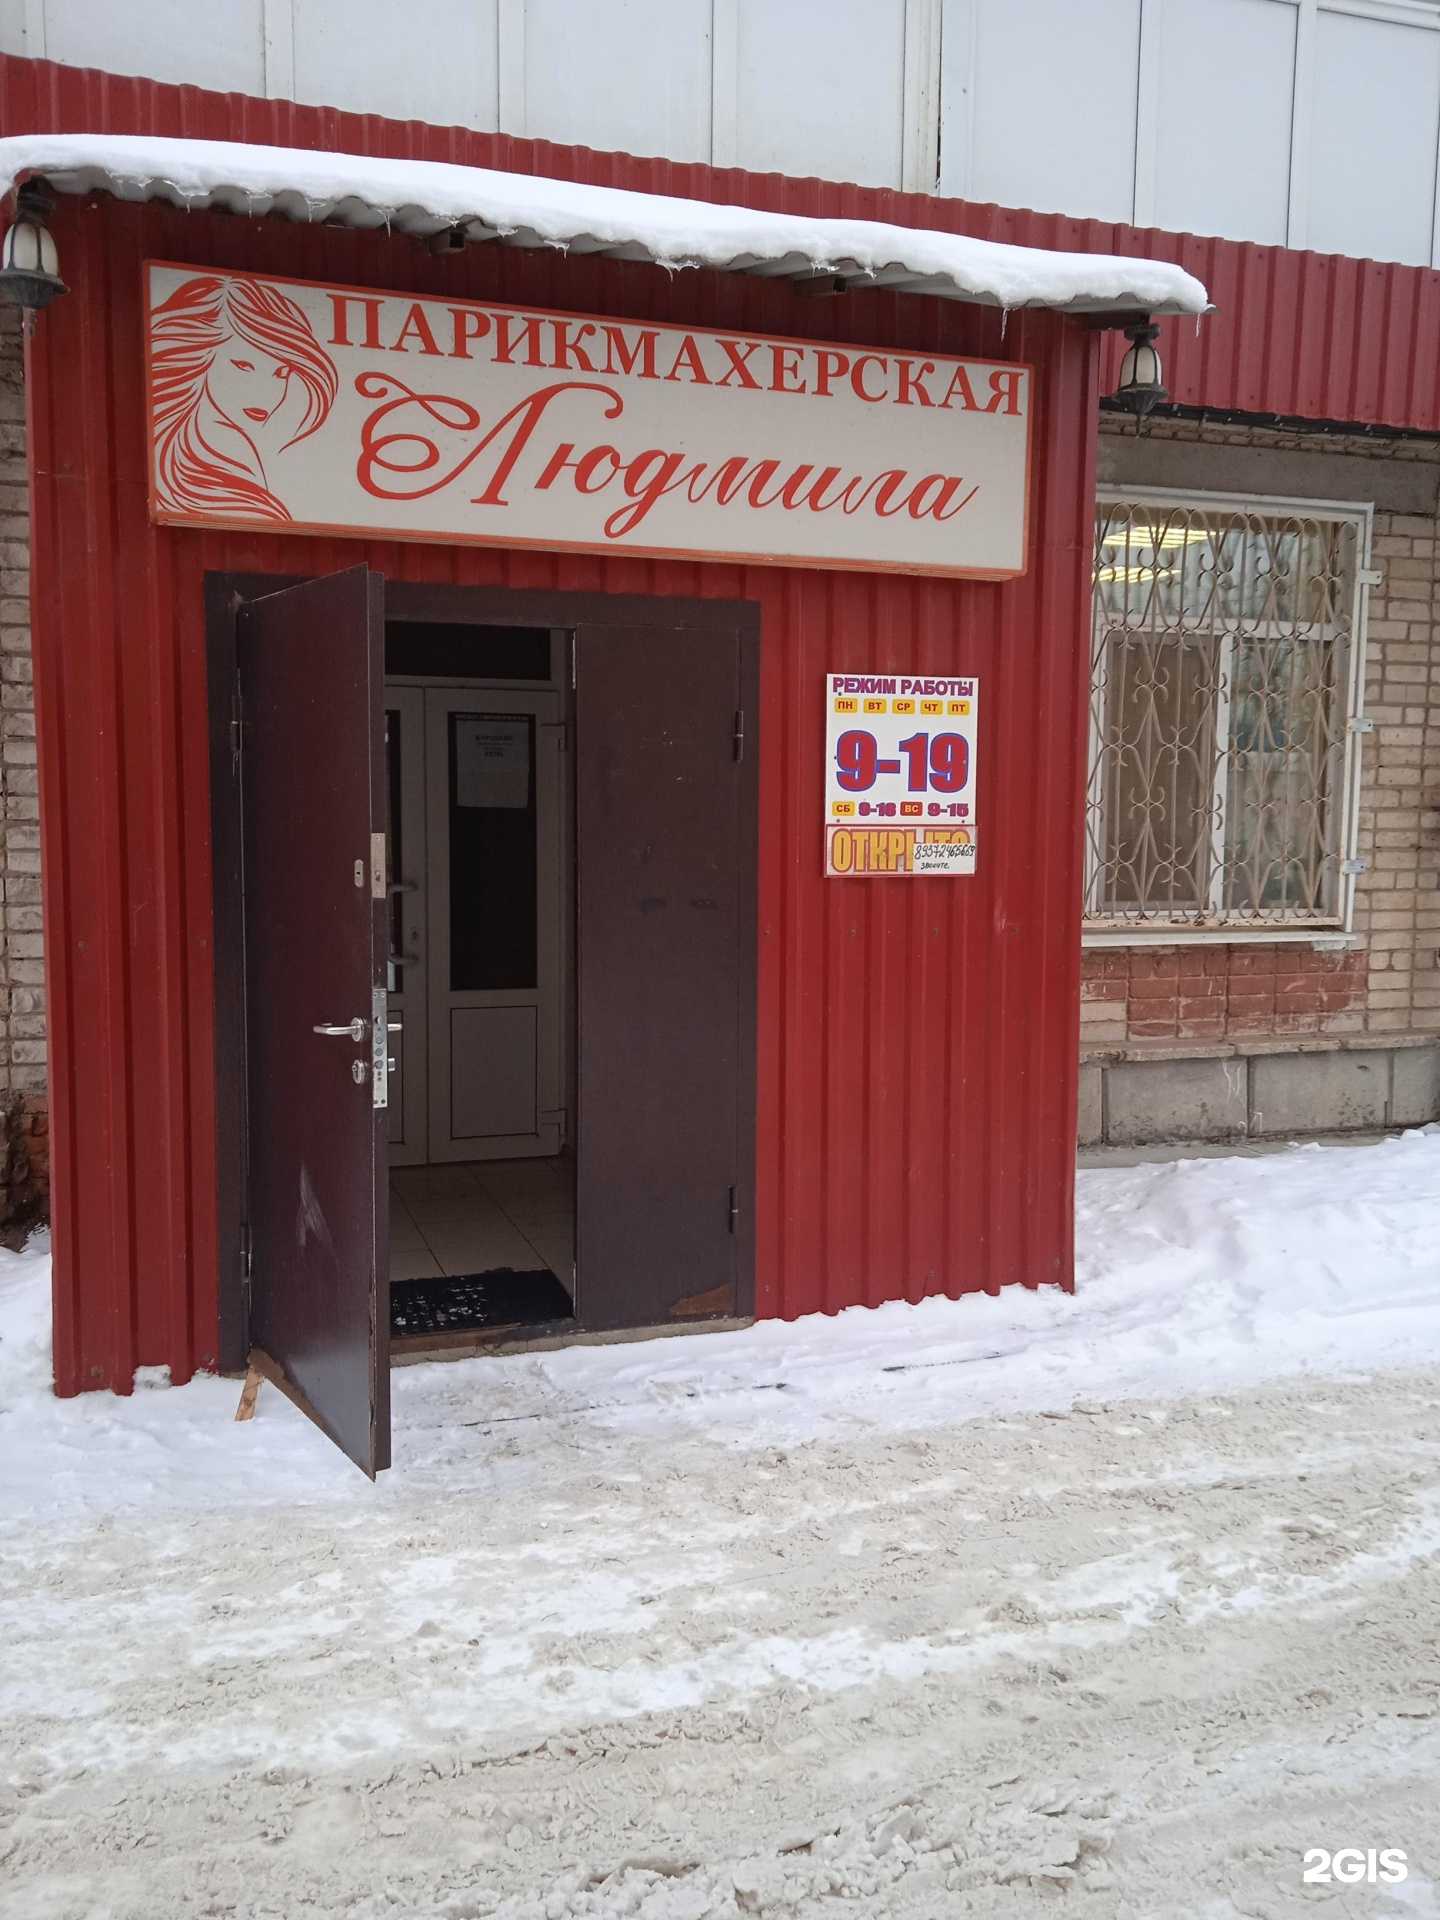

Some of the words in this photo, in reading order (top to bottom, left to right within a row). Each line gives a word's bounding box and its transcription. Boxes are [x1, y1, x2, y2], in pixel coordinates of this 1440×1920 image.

[325, 294, 1023, 416] ПАРИКМАХЕРСКАЯ
[355, 371, 980, 539] Людмила
[832, 677, 896, 694] РЕЖИМ
[900, 680, 973, 696] РАБОТЫ
[838, 701, 853, 710] ПН
[868, 702, 882, 710] ВТ
[896, 703, 911, 711] СР
[924, 703, 938, 712] ЧТ
[951, 704, 965, 712] ПТ
[836, 730, 969, 793] 9-19
[836, 804, 850, 813] СБ
[904, 804, 919, 813] ВС
